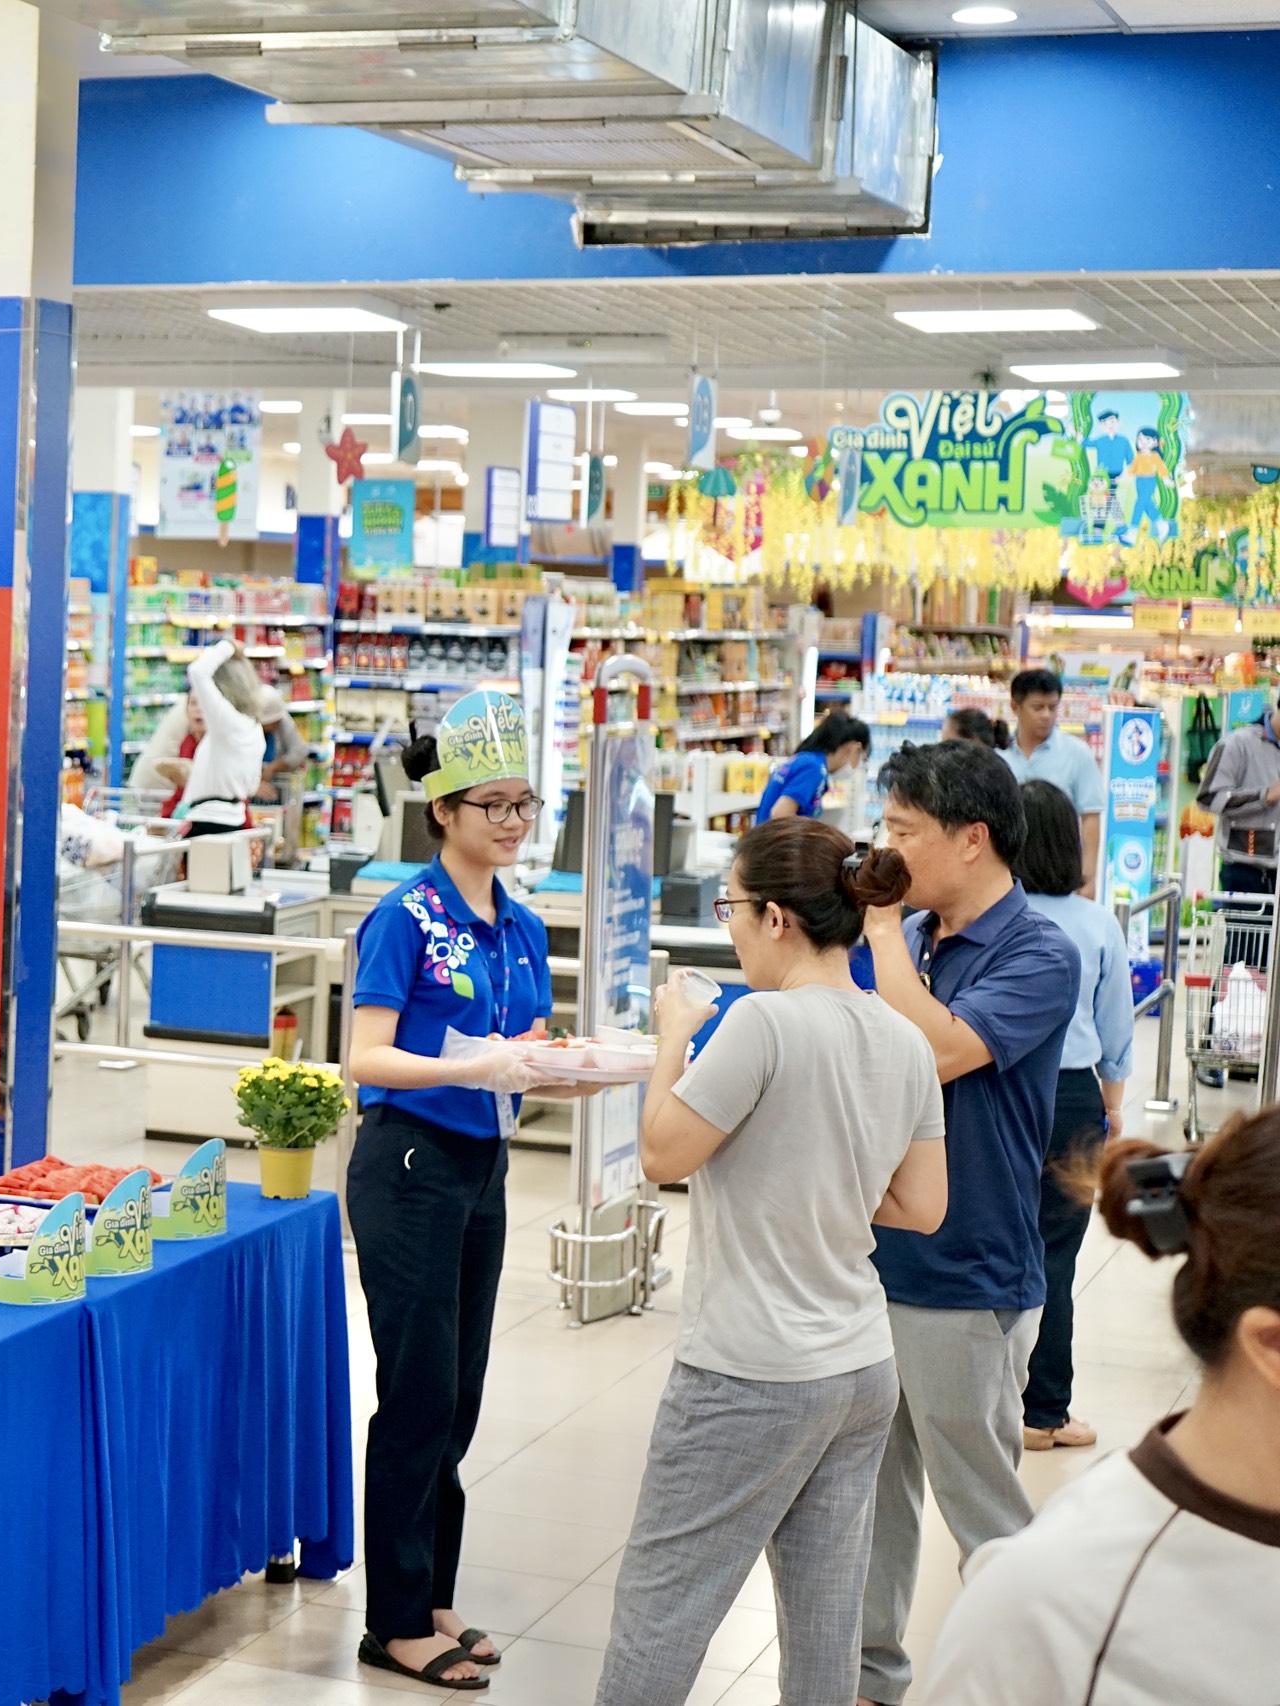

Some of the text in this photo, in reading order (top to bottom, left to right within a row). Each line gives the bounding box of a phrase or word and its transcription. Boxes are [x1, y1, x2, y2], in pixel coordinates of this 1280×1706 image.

[885, 391, 1003, 461] Việt
[832, 428, 908, 449] Gia đình
[938, 437, 996, 461] Đại sứ
[859, 430, 1039, 527] XANH
[181, 1187, 194, 1196] Gia
[104, 1219, 119, 1229] Gia
[39, 1245, 54, 1256] Gia
